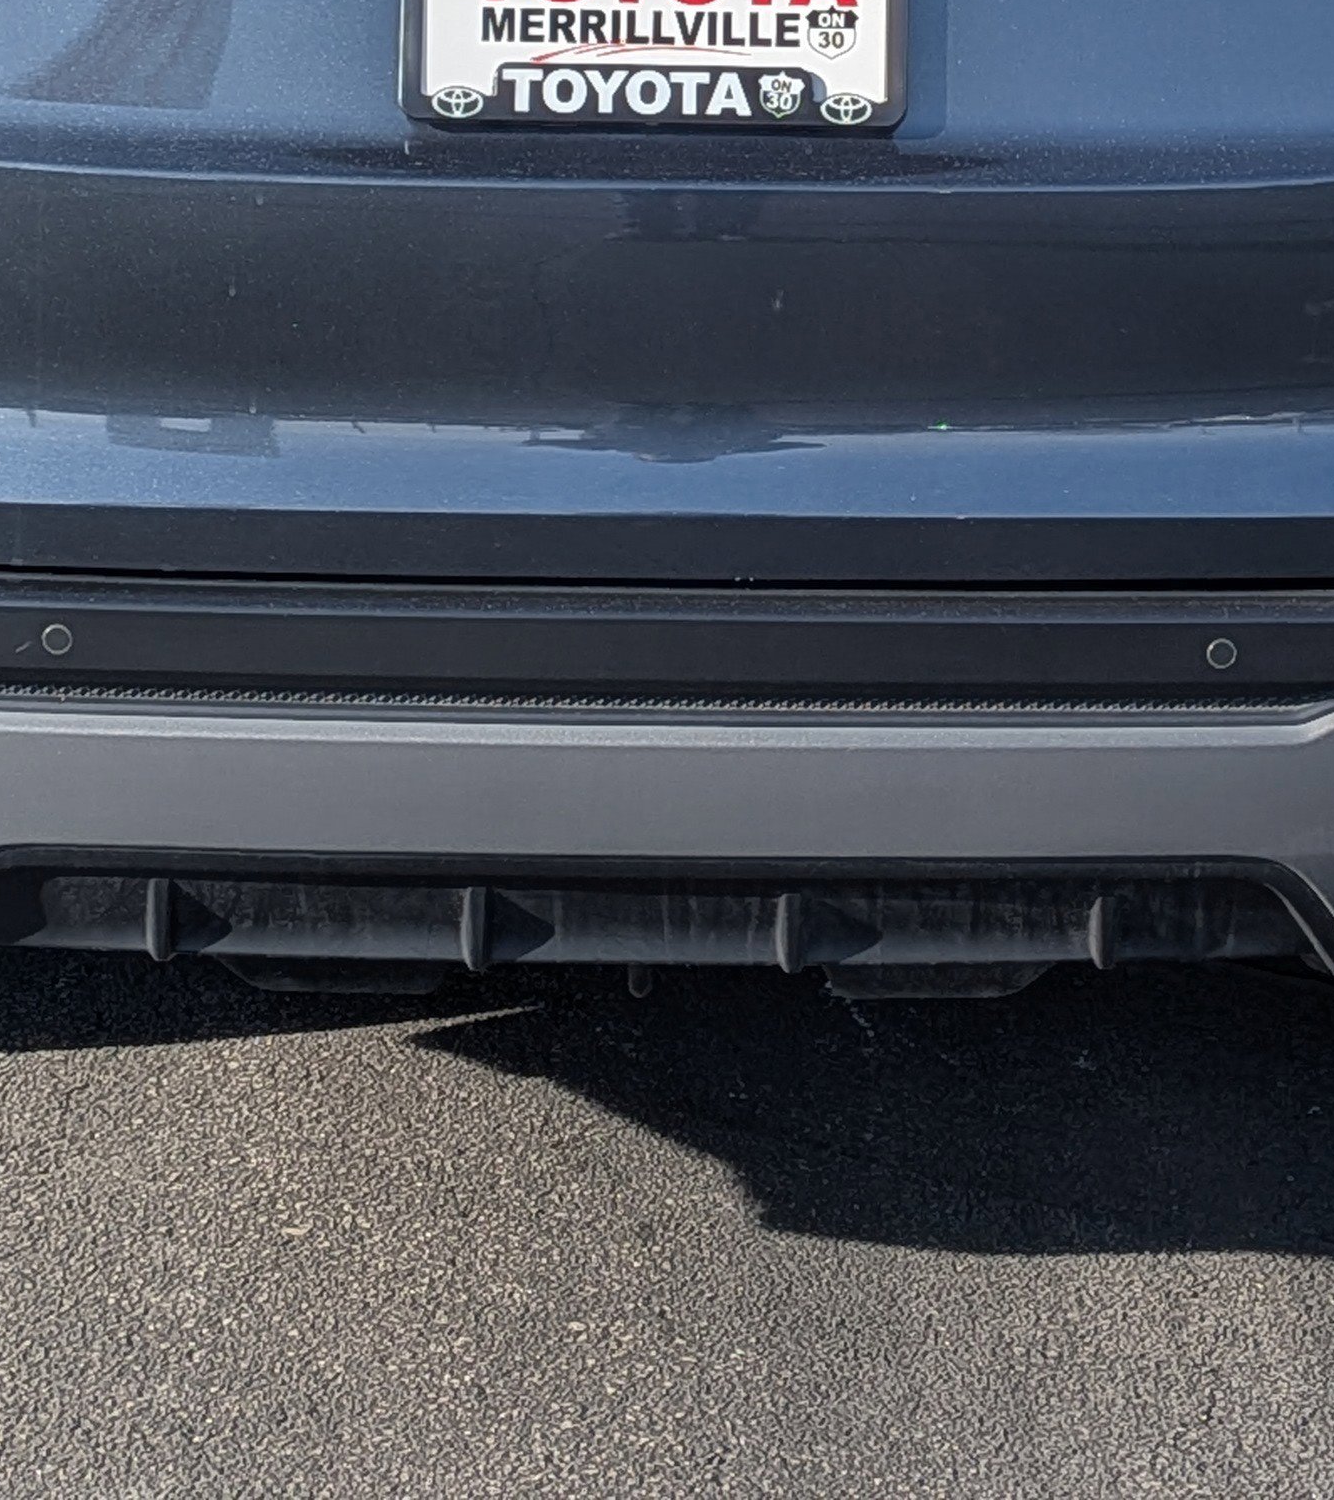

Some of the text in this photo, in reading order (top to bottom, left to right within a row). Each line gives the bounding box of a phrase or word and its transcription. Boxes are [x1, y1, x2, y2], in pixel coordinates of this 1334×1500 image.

[481, 7, 800, 47] MERRILLVILLE
[818, 12, 845, 27] ON
[818, 32, 844, 49] 30
[502, 69, 752, 116] TOYOTA
[771, 79, 792, 92] ON
[766, 91, 793, 110] 30
